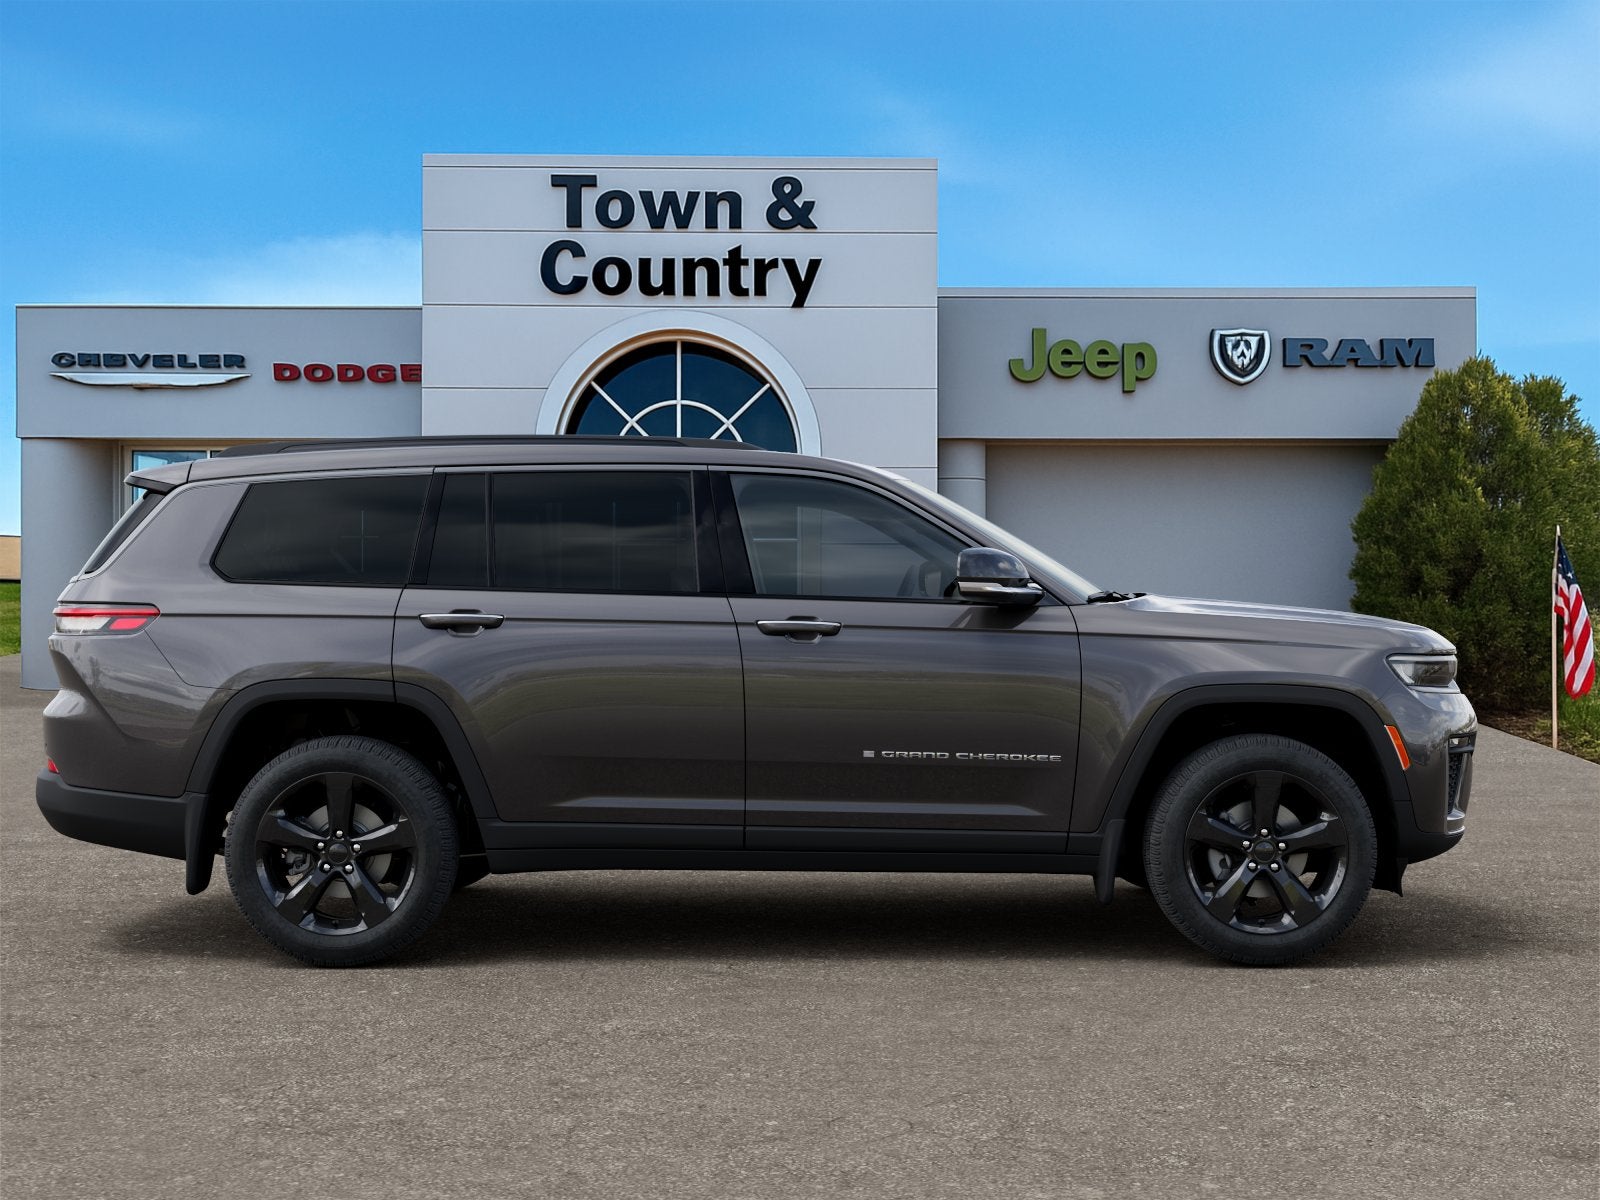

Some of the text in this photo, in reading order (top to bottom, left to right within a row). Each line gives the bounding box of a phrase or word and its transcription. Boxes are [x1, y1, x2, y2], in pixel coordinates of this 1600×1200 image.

[551, 174, 818, 229] Town &
[540, 240, 822, 308] Country
[273, 362, 421, 383] DODGE
[1009, 328, 1157, 392] Jeep
[1283, 338, 1435, 367] RAM
[881, 750, 1062, 762] GRAND CHEROKEE
